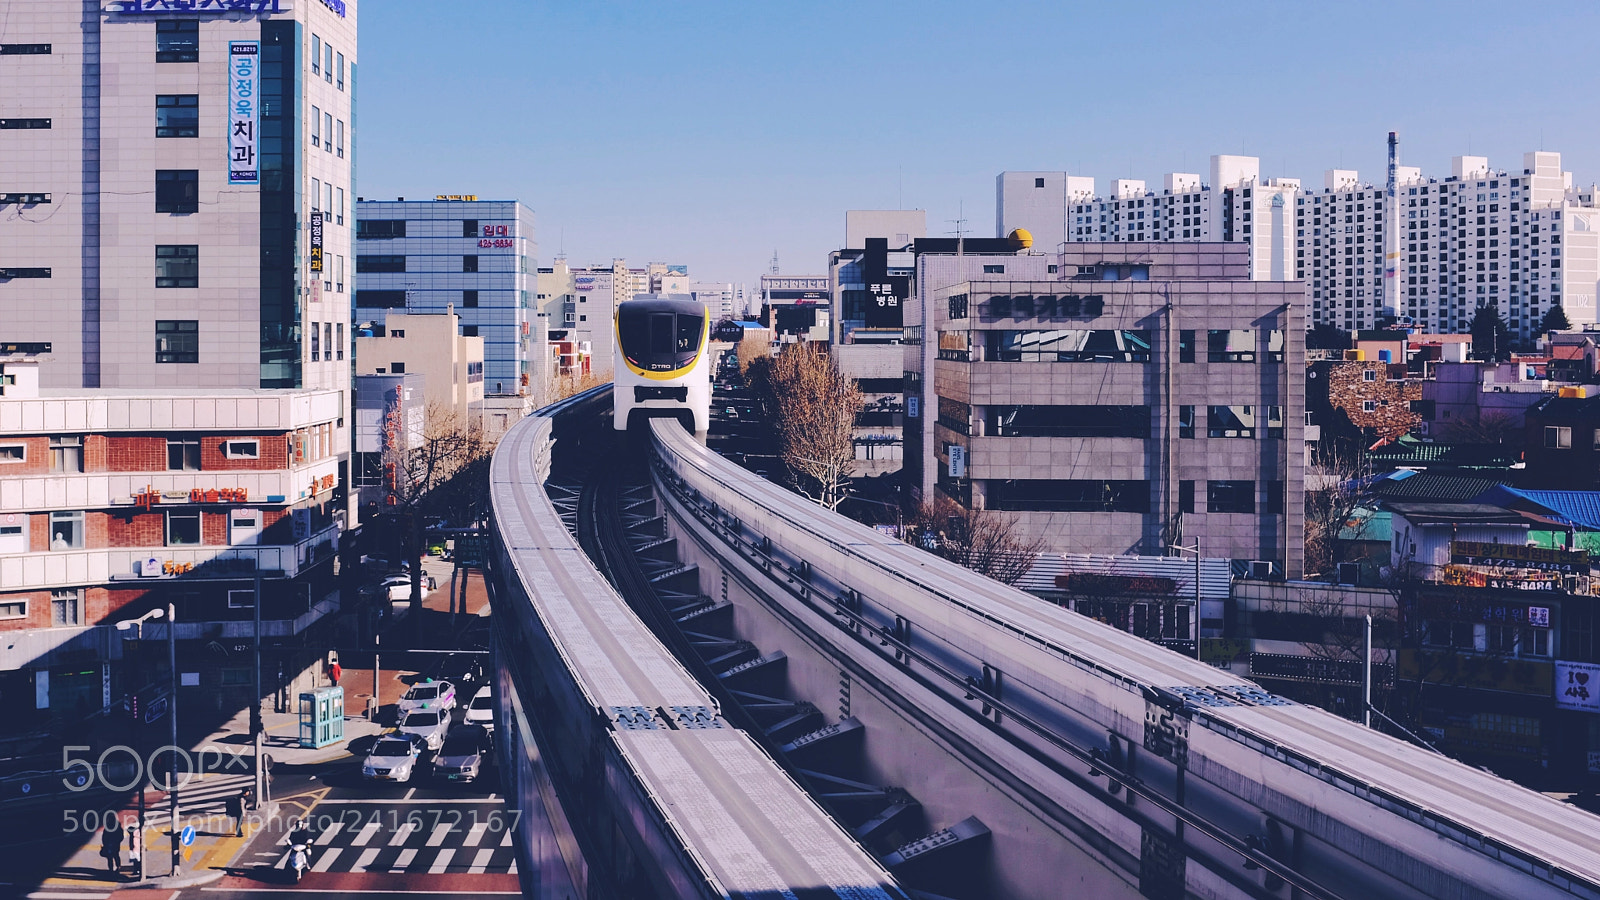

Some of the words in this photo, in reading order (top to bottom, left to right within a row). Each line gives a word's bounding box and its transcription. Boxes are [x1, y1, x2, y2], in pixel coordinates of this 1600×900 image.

[235, 58, 253, 118] 공정욱
[233, 120, 255, 165] 치과
[312, 216, 322, 246] 공정욱
[311, 248, 322, 271] 치과
[870, 283, 892, 295] 푸른
[876, 295, 898, 307] 병원
[1576, 295, 1588, 308] 102
[190, 487, 248, 503] 미술학원
[1568, 671, 1575, 684] I
[1564, 686, 1589, 701] 사주
